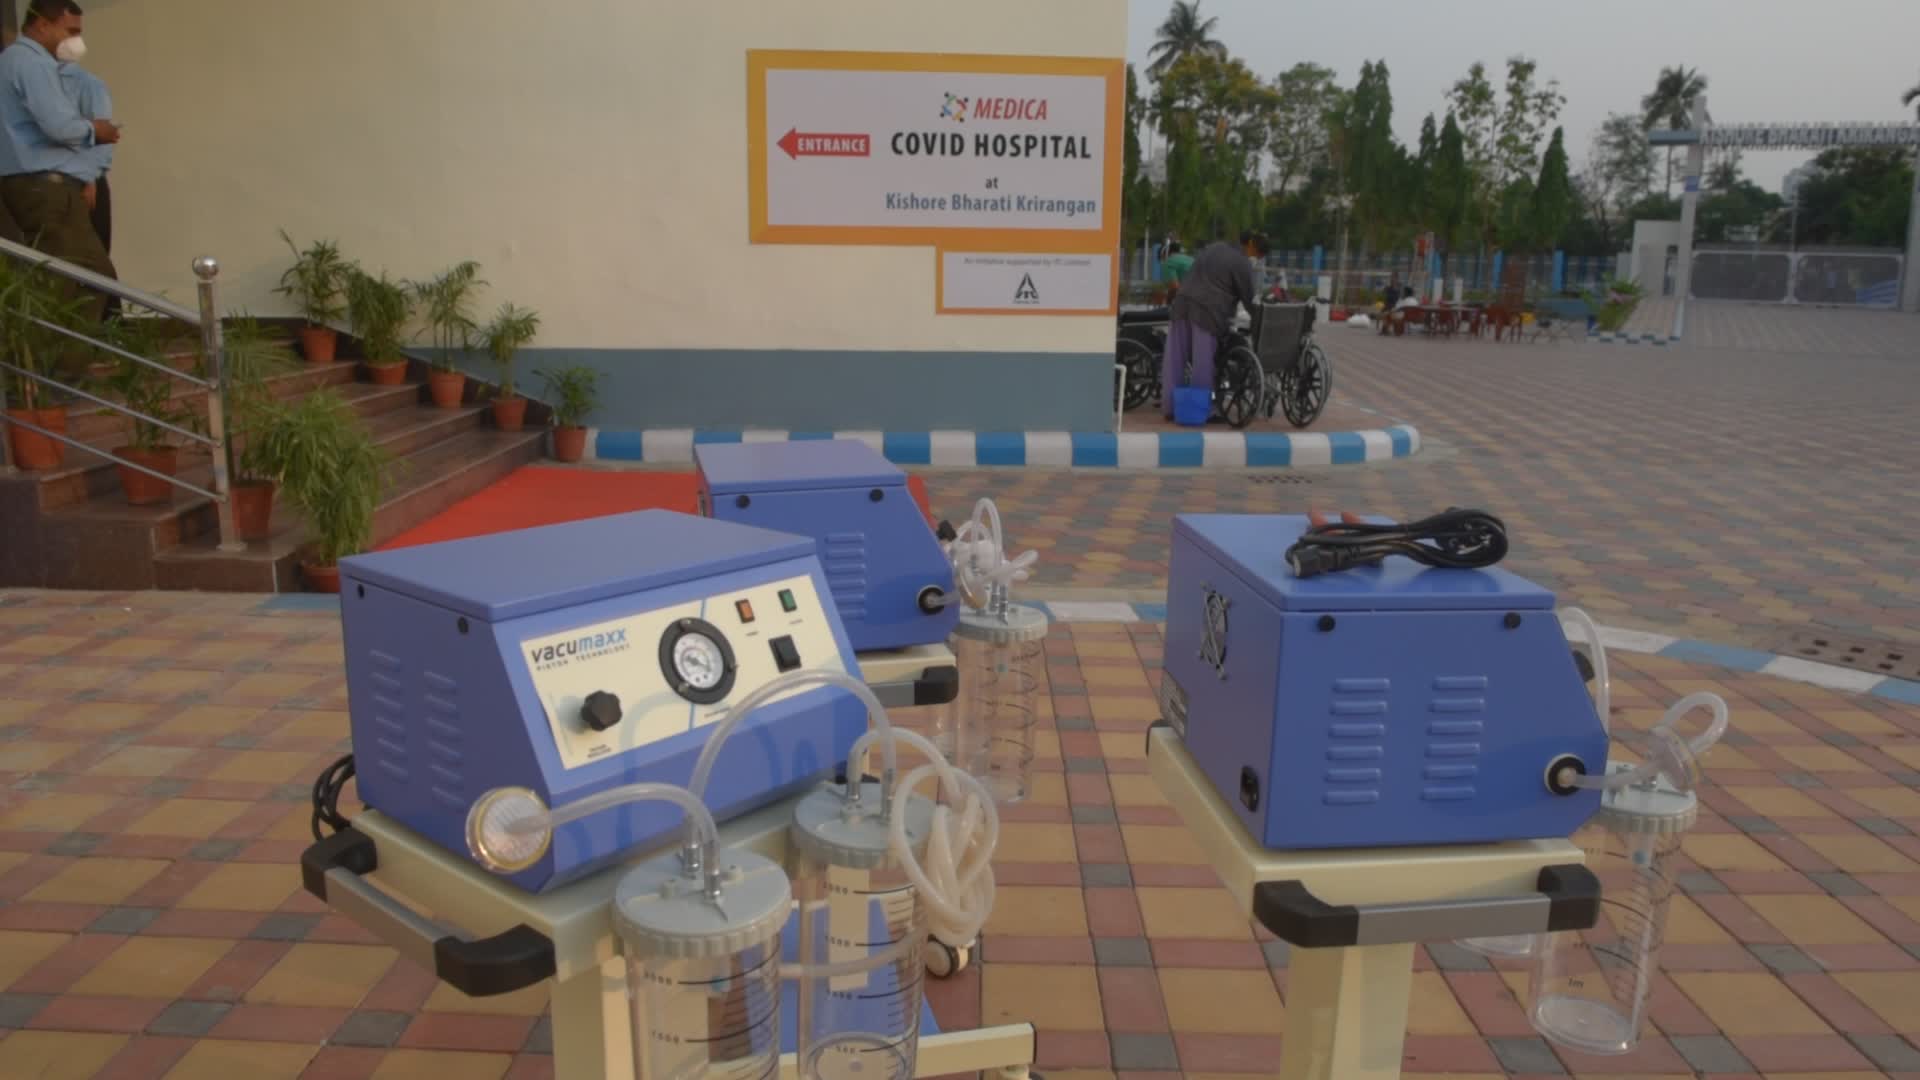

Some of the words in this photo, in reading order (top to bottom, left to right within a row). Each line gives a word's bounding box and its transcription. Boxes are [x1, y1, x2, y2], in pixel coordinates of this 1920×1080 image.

[973, 97, 1048, 121] MEDICA
[797, 137, 866, 153] ENTRANCE
[890, 132, 965, 157] COVID
[974, 133, 1091, 159] HOSPITAL
[985, 176, 999, 189] at
[886, 193, 946, 210] Kishore
[951, 194, 1012, 212] Bharati
[1016, 196, 1096, 216] Krirangan
[531, 628, 626, 664] vacumaxx
